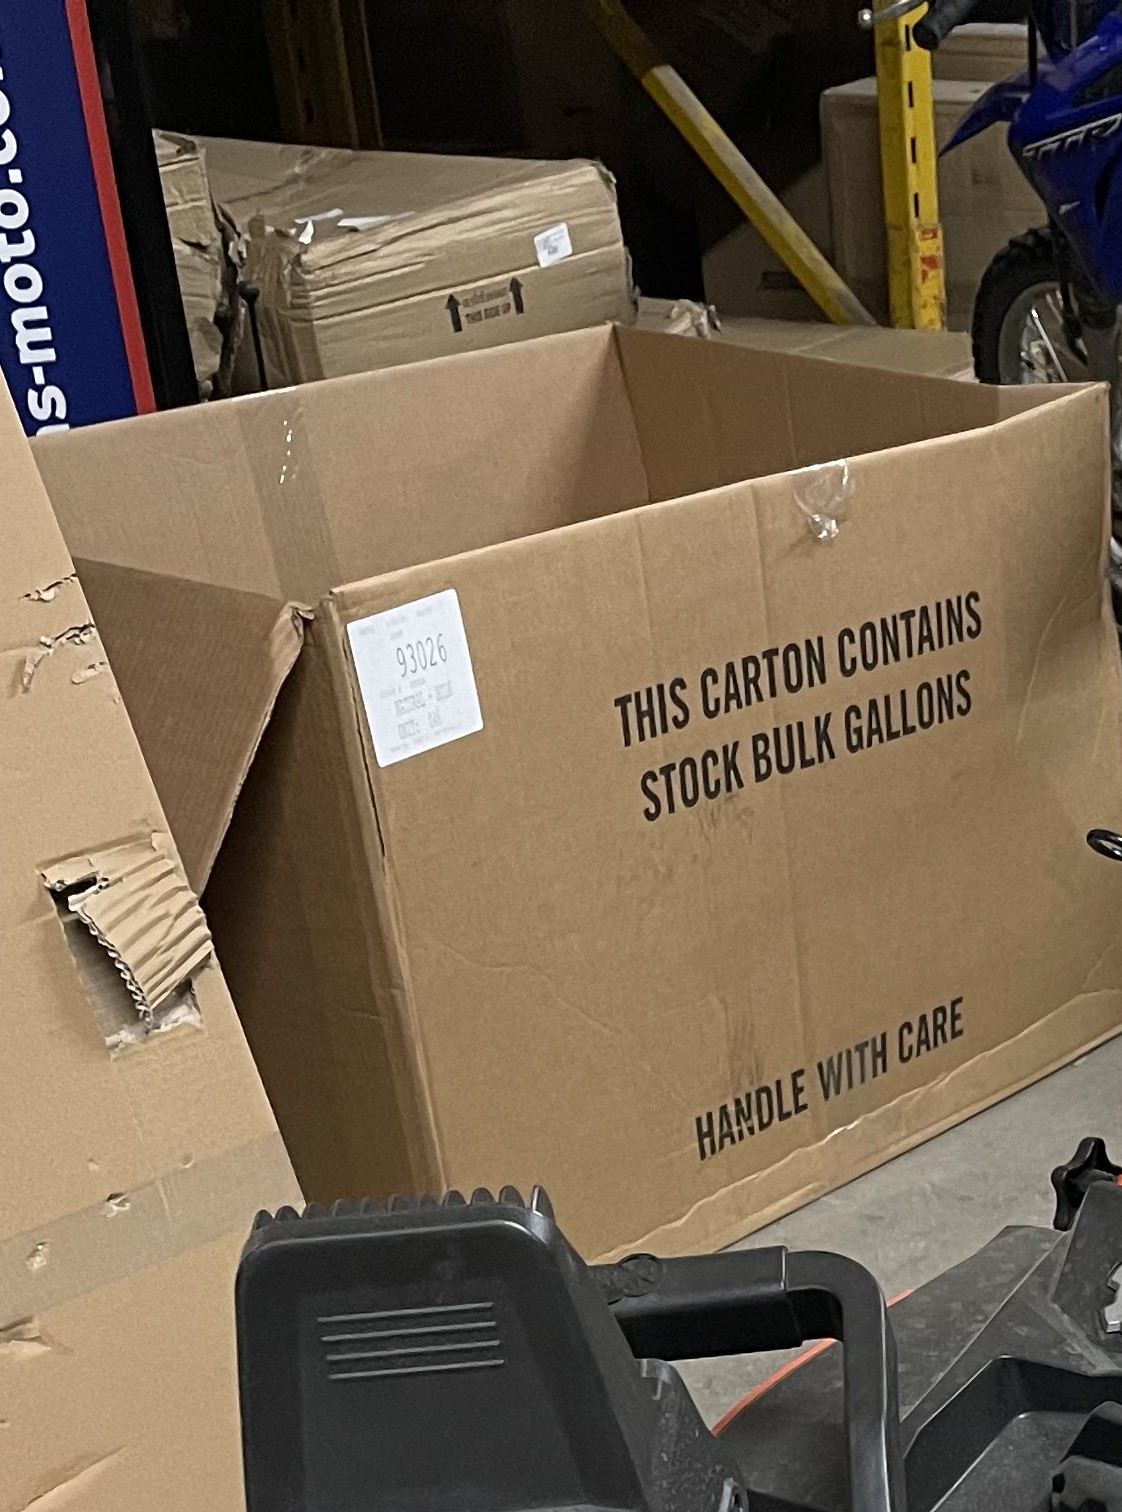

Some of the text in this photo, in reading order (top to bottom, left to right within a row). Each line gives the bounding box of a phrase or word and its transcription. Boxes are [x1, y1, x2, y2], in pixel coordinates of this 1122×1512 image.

[396, 632, 448, 678] 93026
[613, 590, 983, 748] THIS CARTON CONTAINS
[640, 669, 973, 822] STOCK BULK GALLONS
[695, 996, 964, 1162] HANDLE WITH CARE
